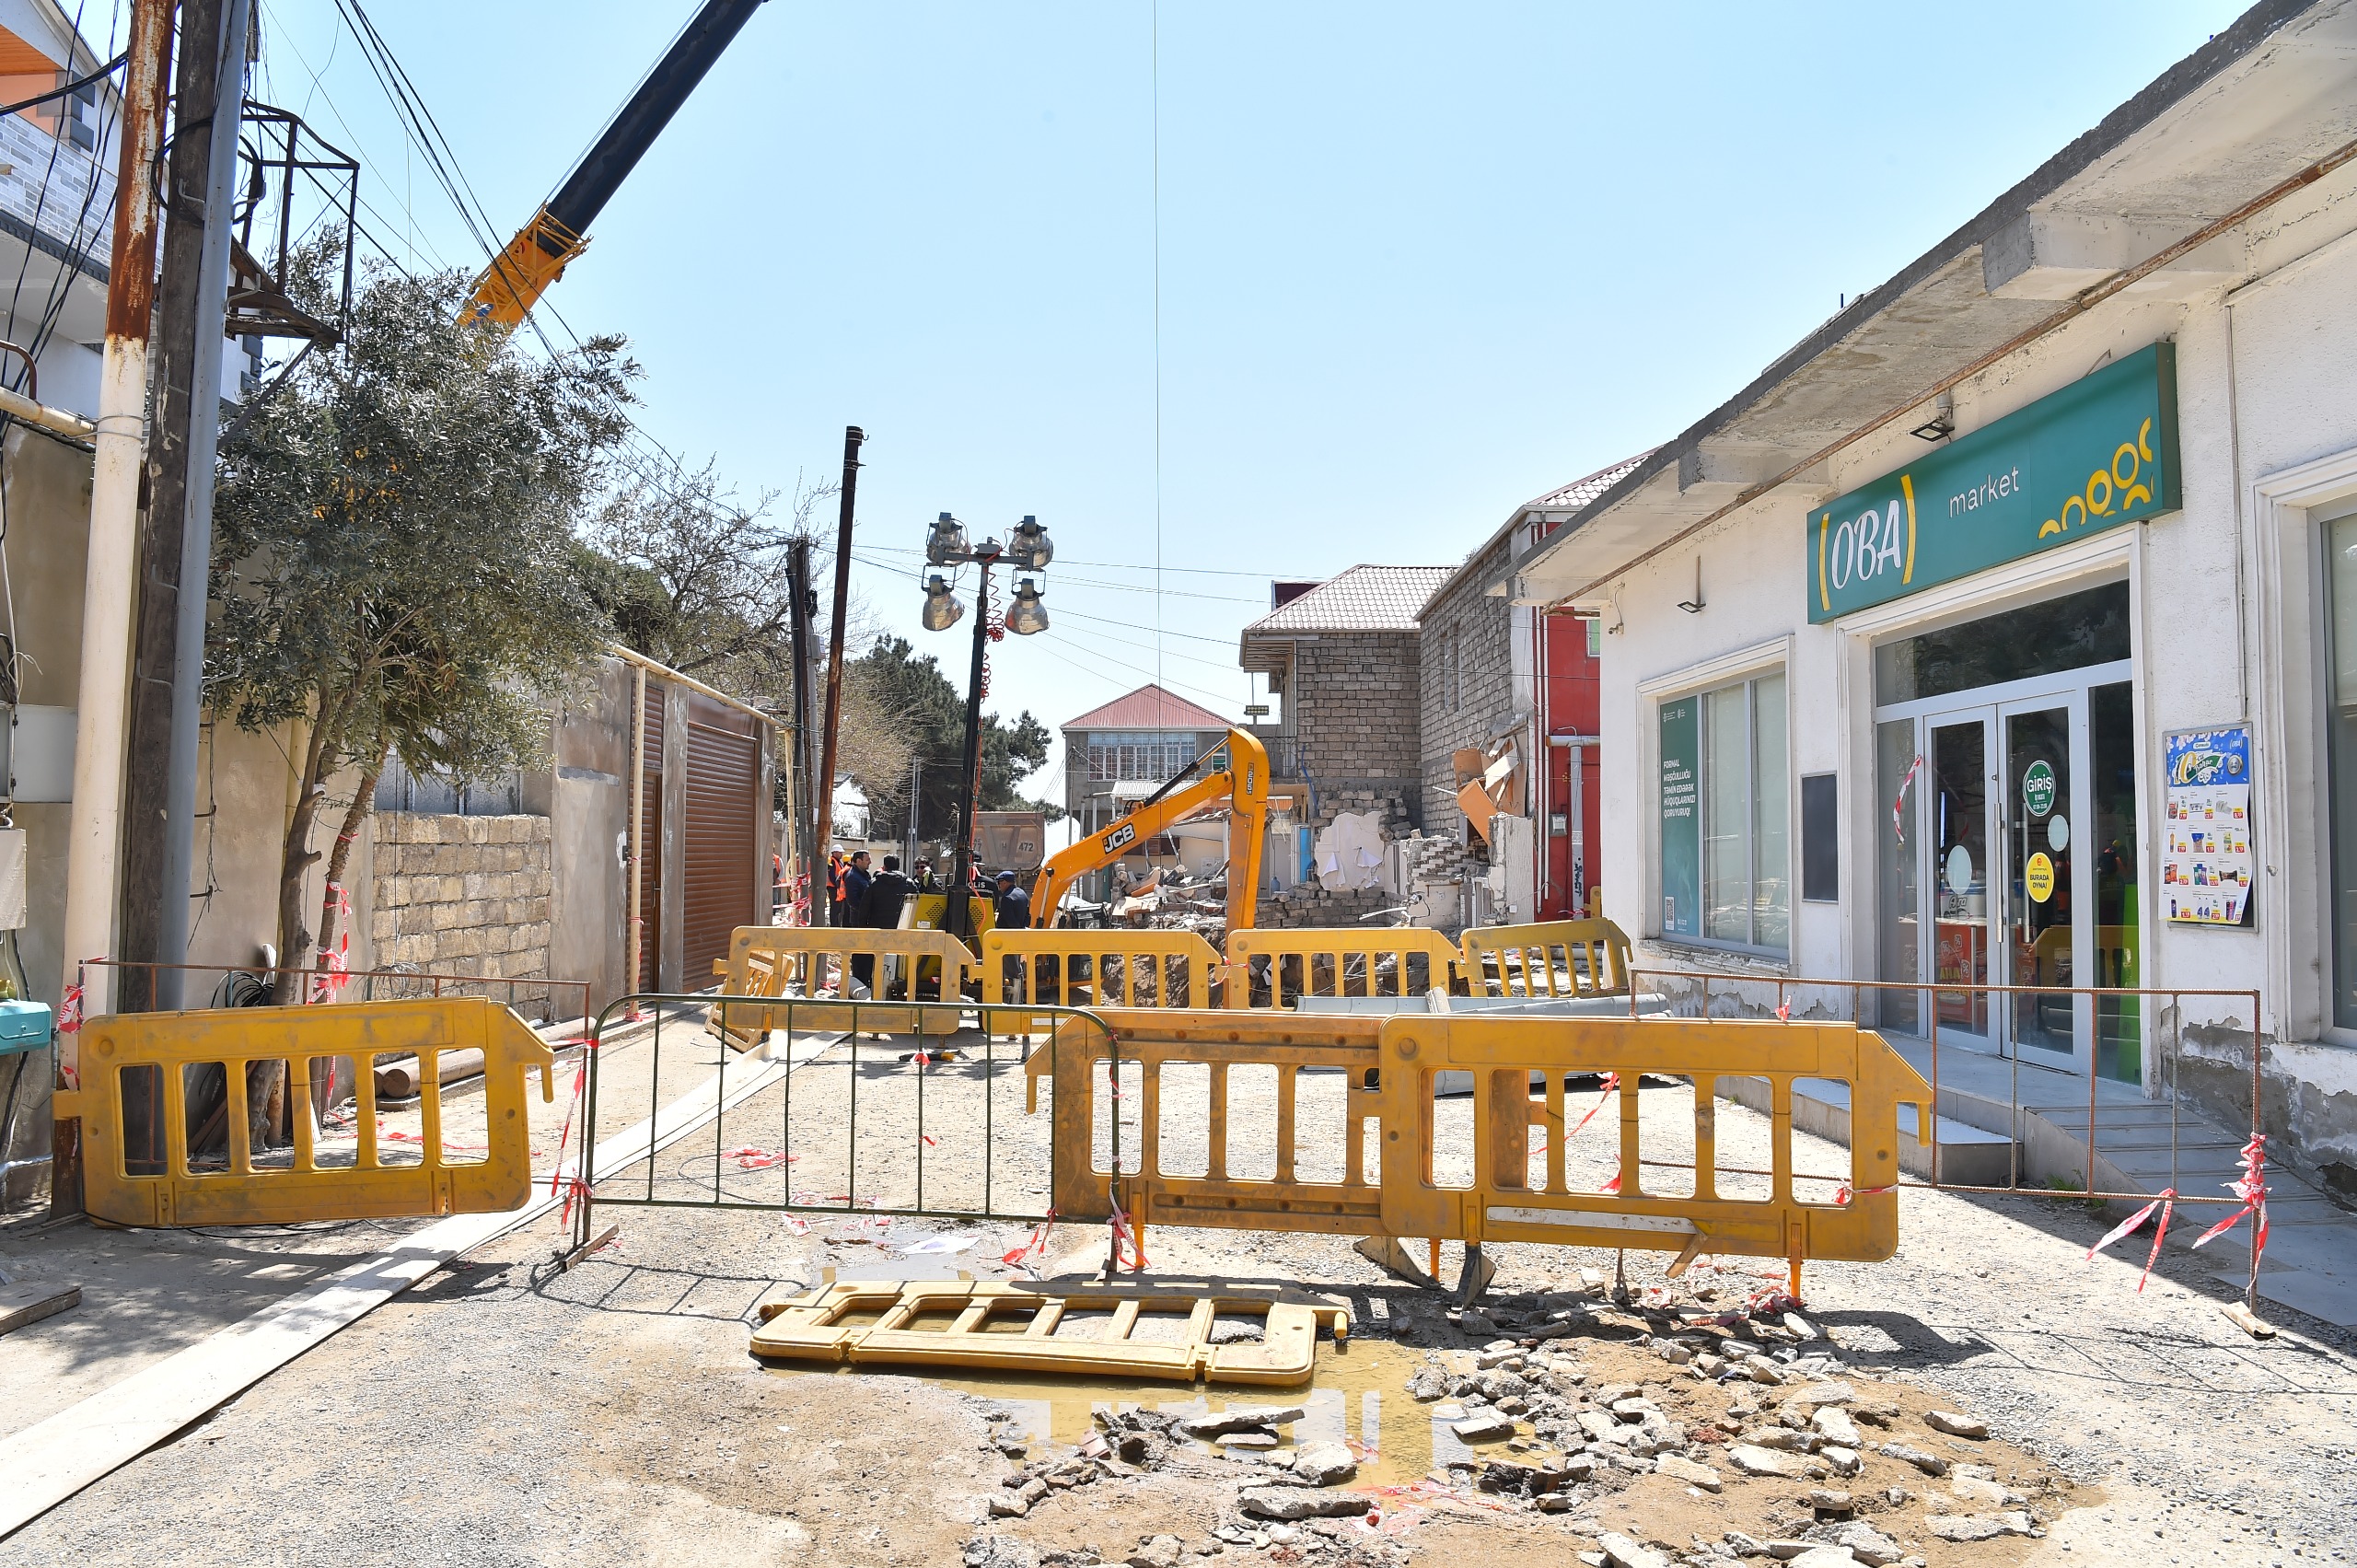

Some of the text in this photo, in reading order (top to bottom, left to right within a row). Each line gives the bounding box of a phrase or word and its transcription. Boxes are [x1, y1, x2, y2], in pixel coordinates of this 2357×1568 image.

[1949, 466, 2019, 518] market
[1663, 759, 1680, 770] FORMAL
[2026, 773, 2052, 795] GİRİŞ
[1018, 842, 1034, 853] 472
[1104, 823, 1135, 854] JCB
